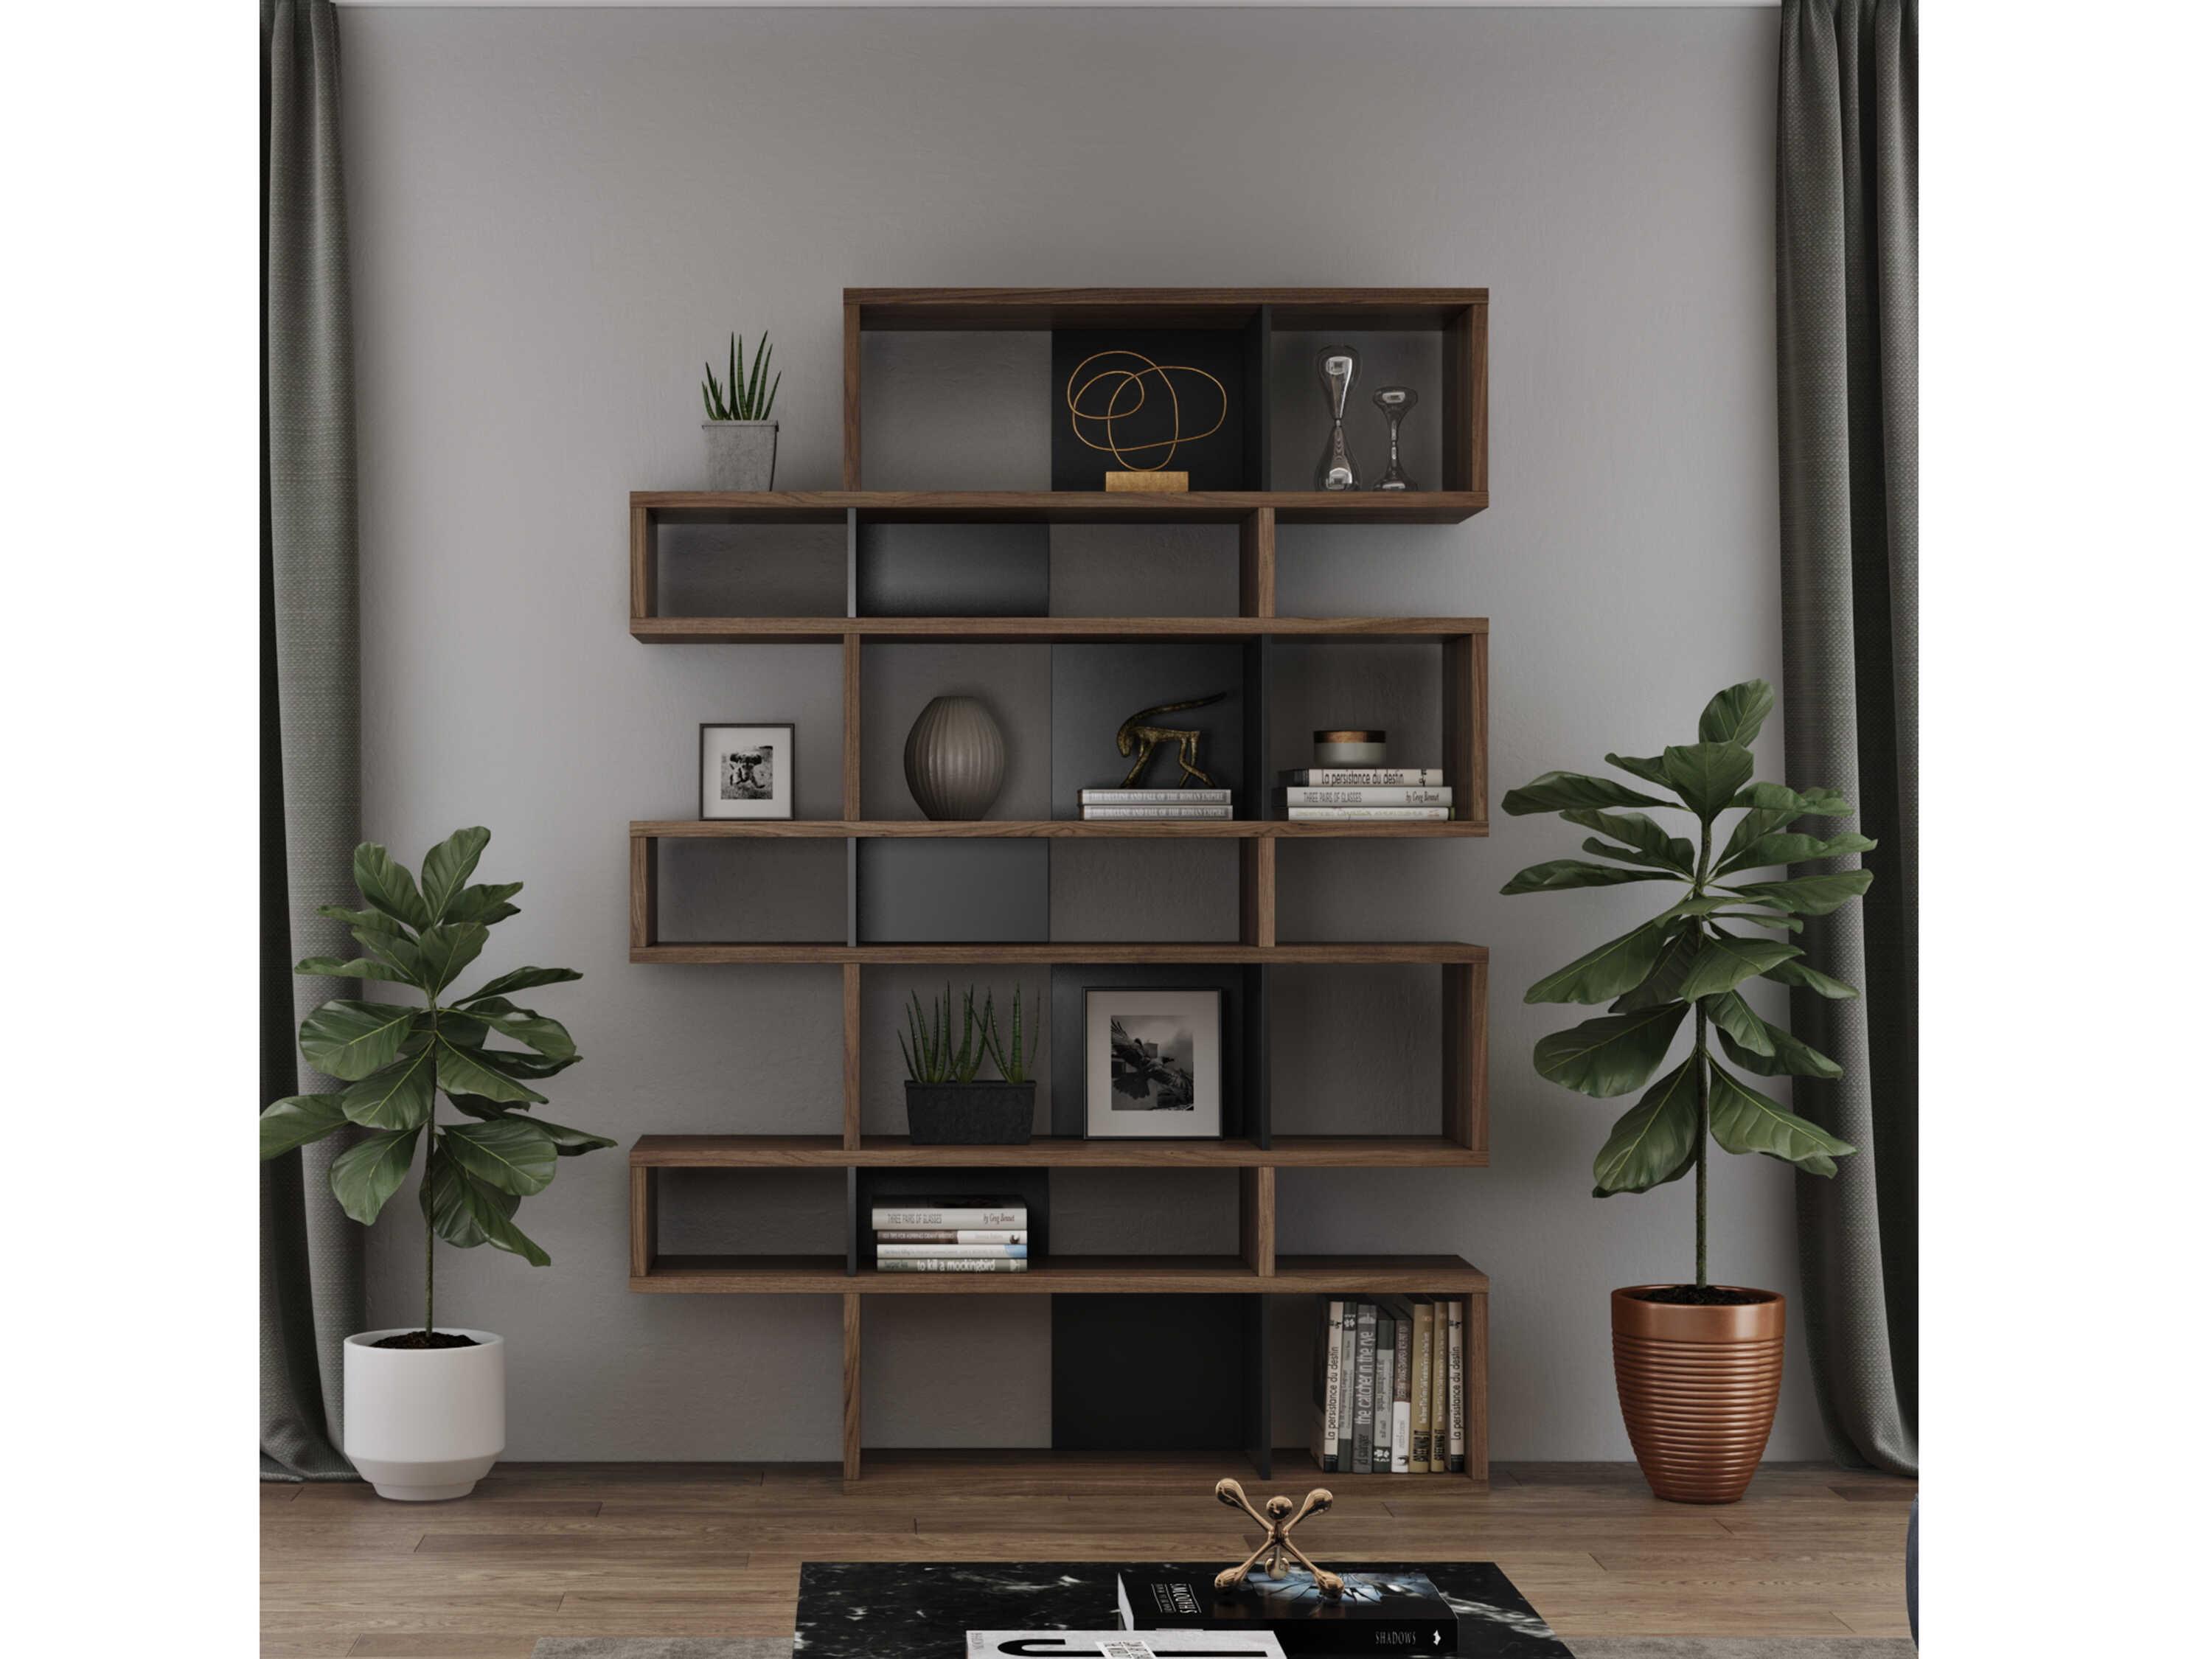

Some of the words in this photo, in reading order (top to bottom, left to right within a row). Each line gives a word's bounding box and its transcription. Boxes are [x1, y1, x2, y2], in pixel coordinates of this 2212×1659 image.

[1332, 770, 1370, 787] persistance
[1372, 769, 1382, 785] du
[1383, 769, 1405, 785] destin
[1131, 793, 1142, 801] AND
[1144, 793, 1156, 801] FALL
[1157, 793, 1165, 801] OF
[1304, 792, 1318, 803] THREE
[1320, 792, 1332, 803] PAIRS
[1333, 792, 1340, 803] OF
[1340, 792, 1362, 803] GLASSES
[1133, 808, 1144, 816] AND
[1144, 808, 1158, 816] FALL
[1159, 808, 1166, 816] OF
[888, 1213, 901, 1224] THREE
[916, 1213, 922, 1224] OF
[923, 1213, 942, 1224] GLASSES
[917, 1259, 925, 1270] to
[927, 1259, 939, 1270] kill
[947, 1259, 995, 1272] mockingbird
[1360, 1332, 1377, 1346] rye
[1328, 1346, 1339, 1370] destin
[1356, 1348, 1373, 1363] the
[1449, 1346, 1461, 1370] destin
[1356, 1365, 1373, 1374] in
[1326, 1372, 1338, 1382] du
[1449, 1372, 1461, 1382] du
[1354, 1374, 1373, 1408] catcher
[1326, 1385, 1338, 1429] persistance
[1451, 1385, 1464, 1429] persistance
[1354, 1410, 1371, 1425] the
[1325, 1432, 1335, 1440] La
[1450, 1432, 1461, 1440] La
[1375, 1631, 1416, 1645] SHADOWS
